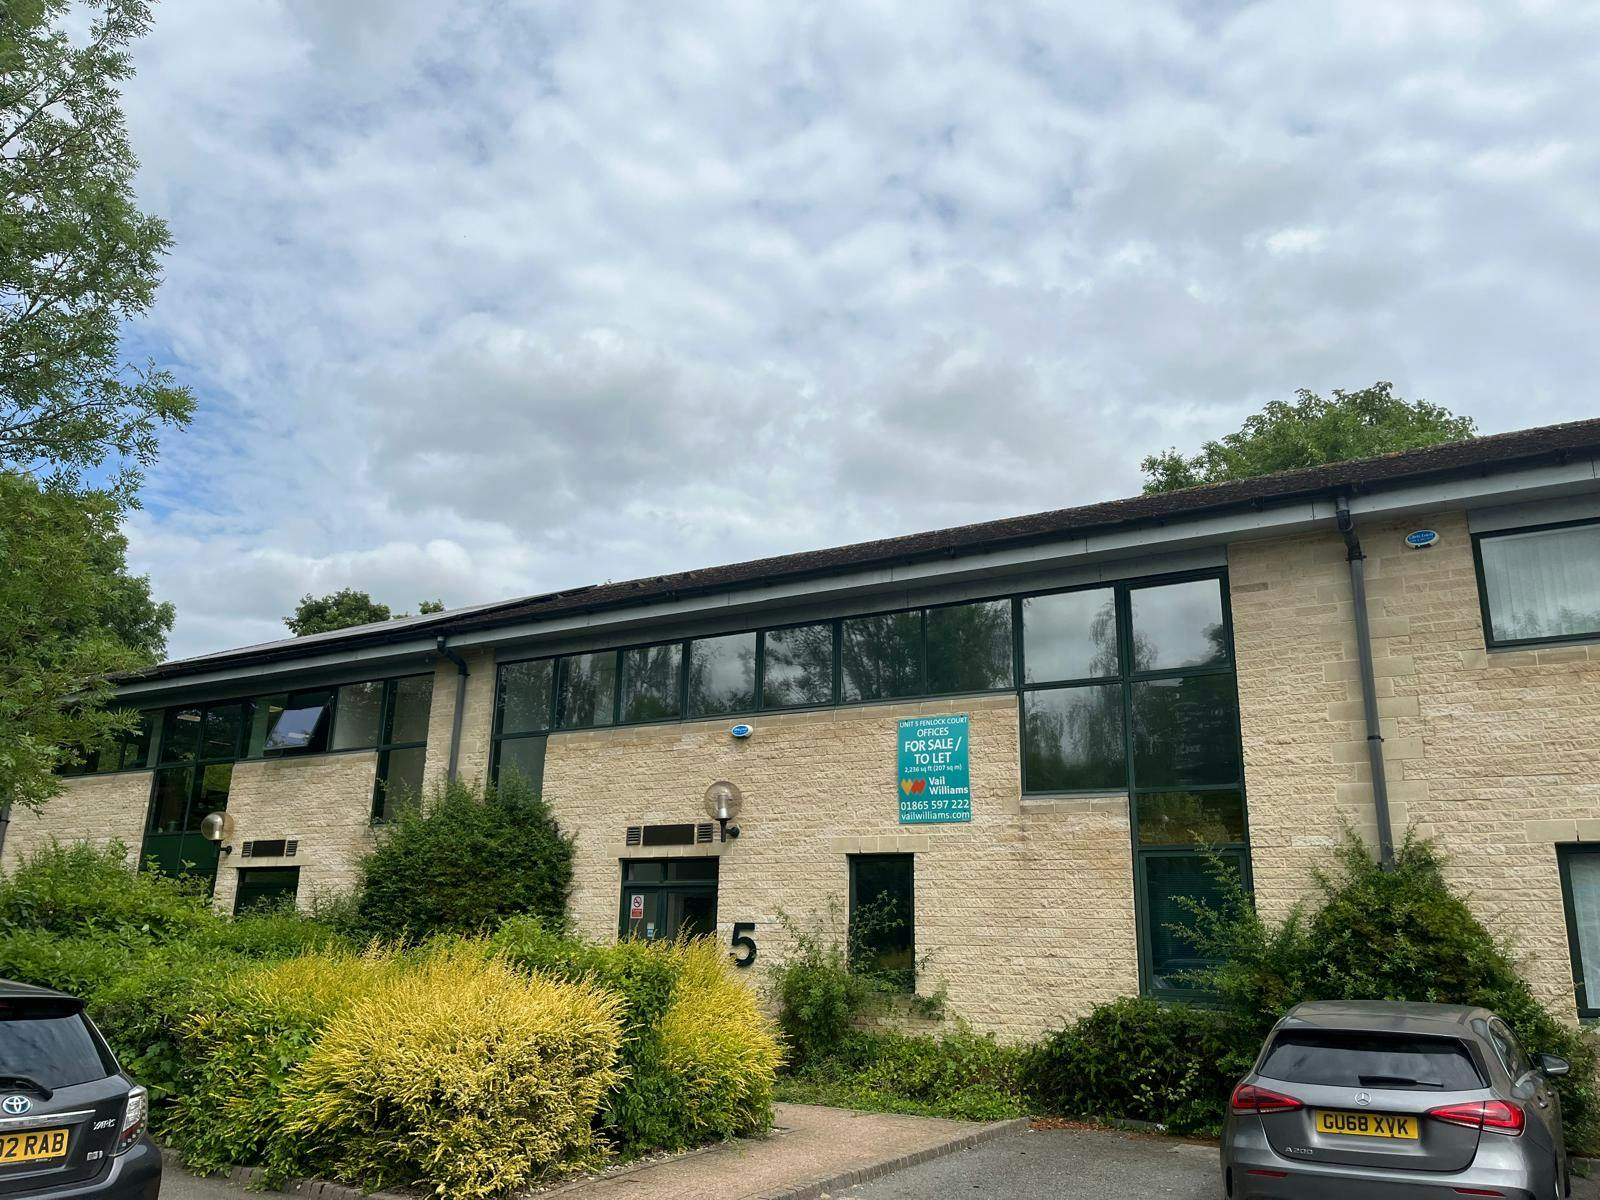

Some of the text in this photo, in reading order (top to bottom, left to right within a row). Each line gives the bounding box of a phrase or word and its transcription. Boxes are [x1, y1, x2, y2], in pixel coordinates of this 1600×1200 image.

[920, 719, 946, 727] FENLOCK
[946, 716, 968, 724] COURT
[917, 727, 949, 737] OFFICES
[905, 740, 926, 752] FOR
[927, 738, 954, 751] SALE
[914, 751, 952, 765] TO LET
[933, 764, 946, 772] (207
[928, 776, 946, 786] Vail
[928, 786, 969, 795] Williams
[900, 799, 970, 811] 01865 597 222
[901, 809, 971, 821] vailwilliams.com
[729, 922, 757, 968] 5
[1323, 1113, 1409, 1135] GU68 XVK
[23, 1132, 65, 1156] RAB
